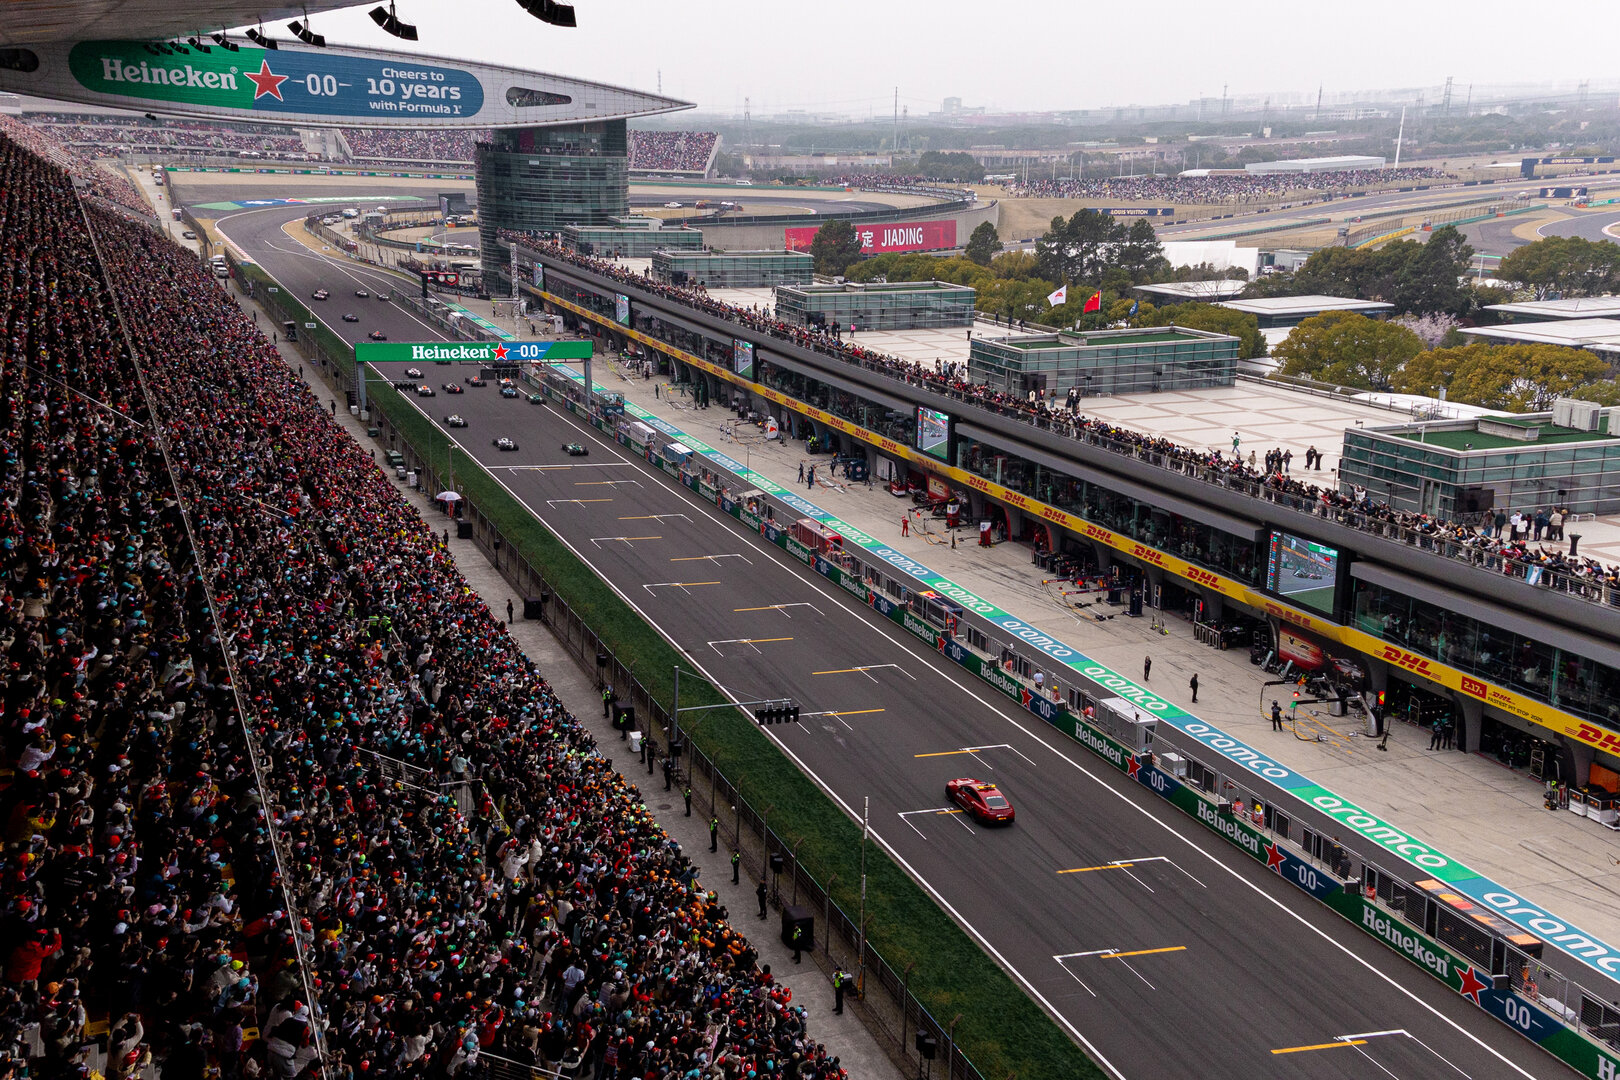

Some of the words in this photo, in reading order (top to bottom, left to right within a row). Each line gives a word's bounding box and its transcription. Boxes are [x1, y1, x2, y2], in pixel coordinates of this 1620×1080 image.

[382, 67, 428, 81] Cheers
[430, 71, 445, 82] to
[367, 78, 396, 96] 10
[400, 83, 461, 100] years
[369, 101, 397, 111] with
[399, 102, 451, 114] Formula
[881, 227, 923, 247] JIADING
[829, 417, 845, 431] DHL
[854, 427, 872, 442] DHL
[880, 438, 899, 453] DHL
[968, 475, 991, 492] DHL
[1004, 490, 1027, 508] DHL
[1042, 507, 1068, 526] DHL
[1086, 524, 1113, 545] DHL
[876, 549, 929, 576] aramco
[1133, 544, 1165, 565] DHL
[1186, 566, 1222, 589] DHL
[934, 581, 994, 613] aramco
[1265, 602, 1312, 628] DHL
[1002, 620, 1073, 657] aramco
[1383, 645, 1433, 677] DHL
[1084, 667, 1169, 710] aramco
[1487, 696, 1507, 708] FASTEST
[1517, 708, 1530, 717] STOP
[1577, 723, 1620, 754] DH
[1185, 723, 1289, 778] aramco
[1313, 796, 1448, 867] aramco
[1483, 892, 1620, 972] aramc
